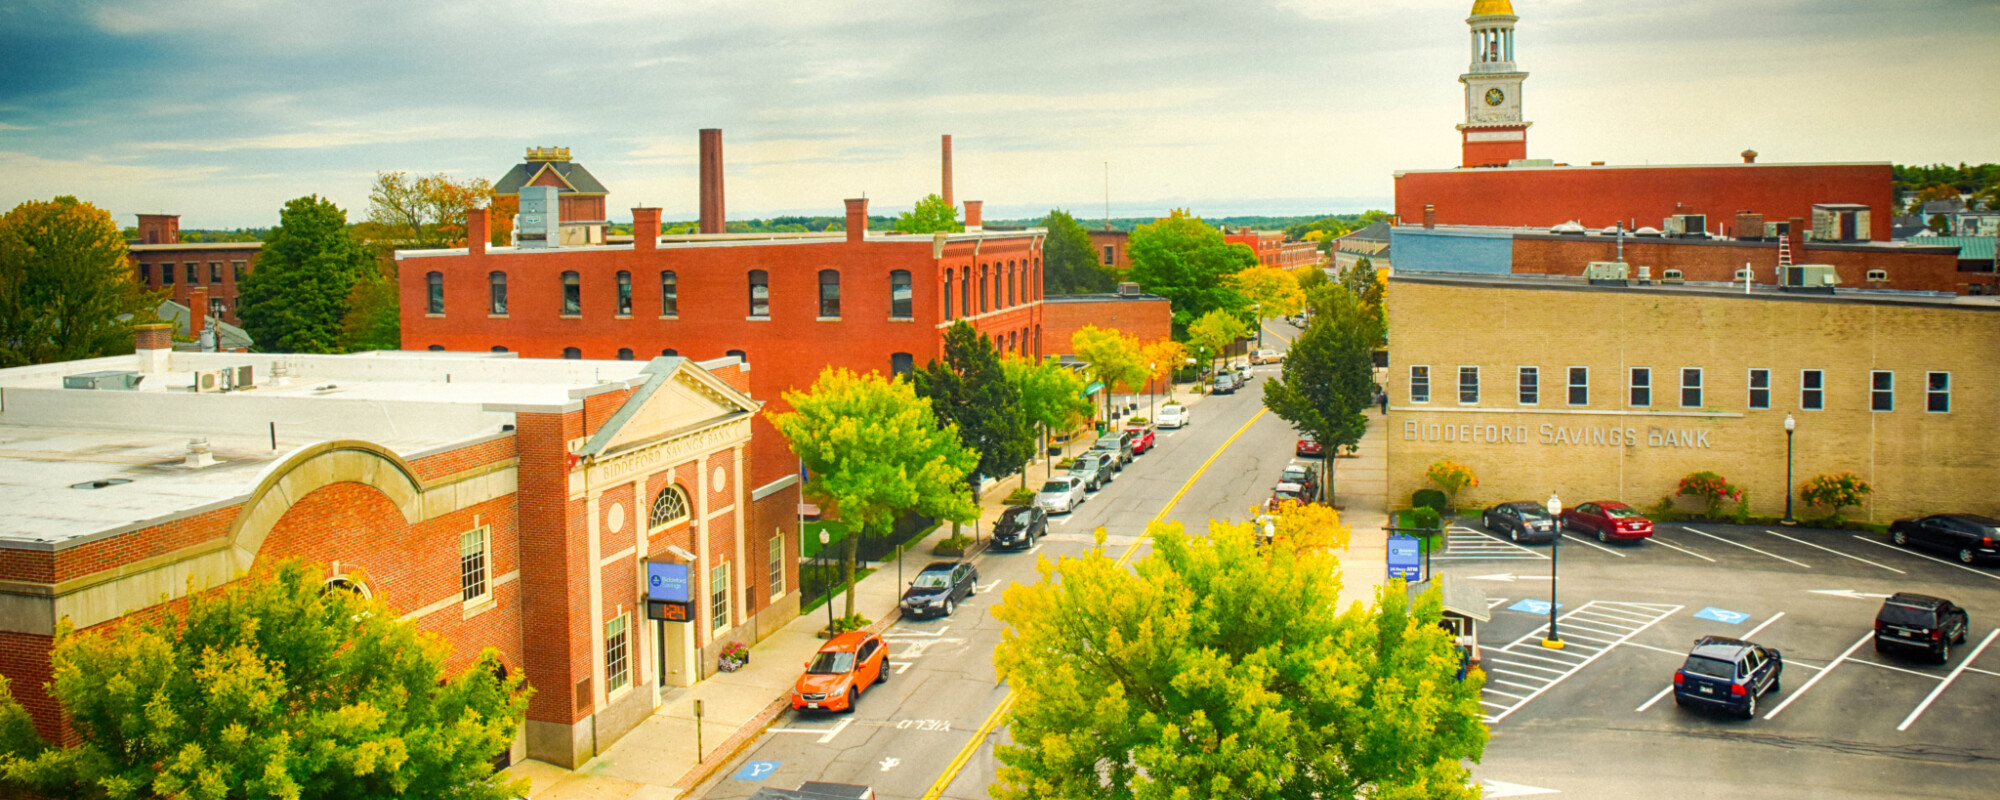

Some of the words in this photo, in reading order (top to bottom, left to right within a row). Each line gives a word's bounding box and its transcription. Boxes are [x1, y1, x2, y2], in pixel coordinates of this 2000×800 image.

[1403, 419, 1528, 444] BIDDEFORD
[1539, 422, 1636, 447] SAVINGS
[1647, 427, 1710, 449] BANK
[603, 450, 661, 480] BIDDEFORD
[666, 437, 704, 458] SAVINGS
[707, 430, 732, 445] BANK
[664, 603, 686, 620] 1:24
[896, 719, 951, 732] YIELD
